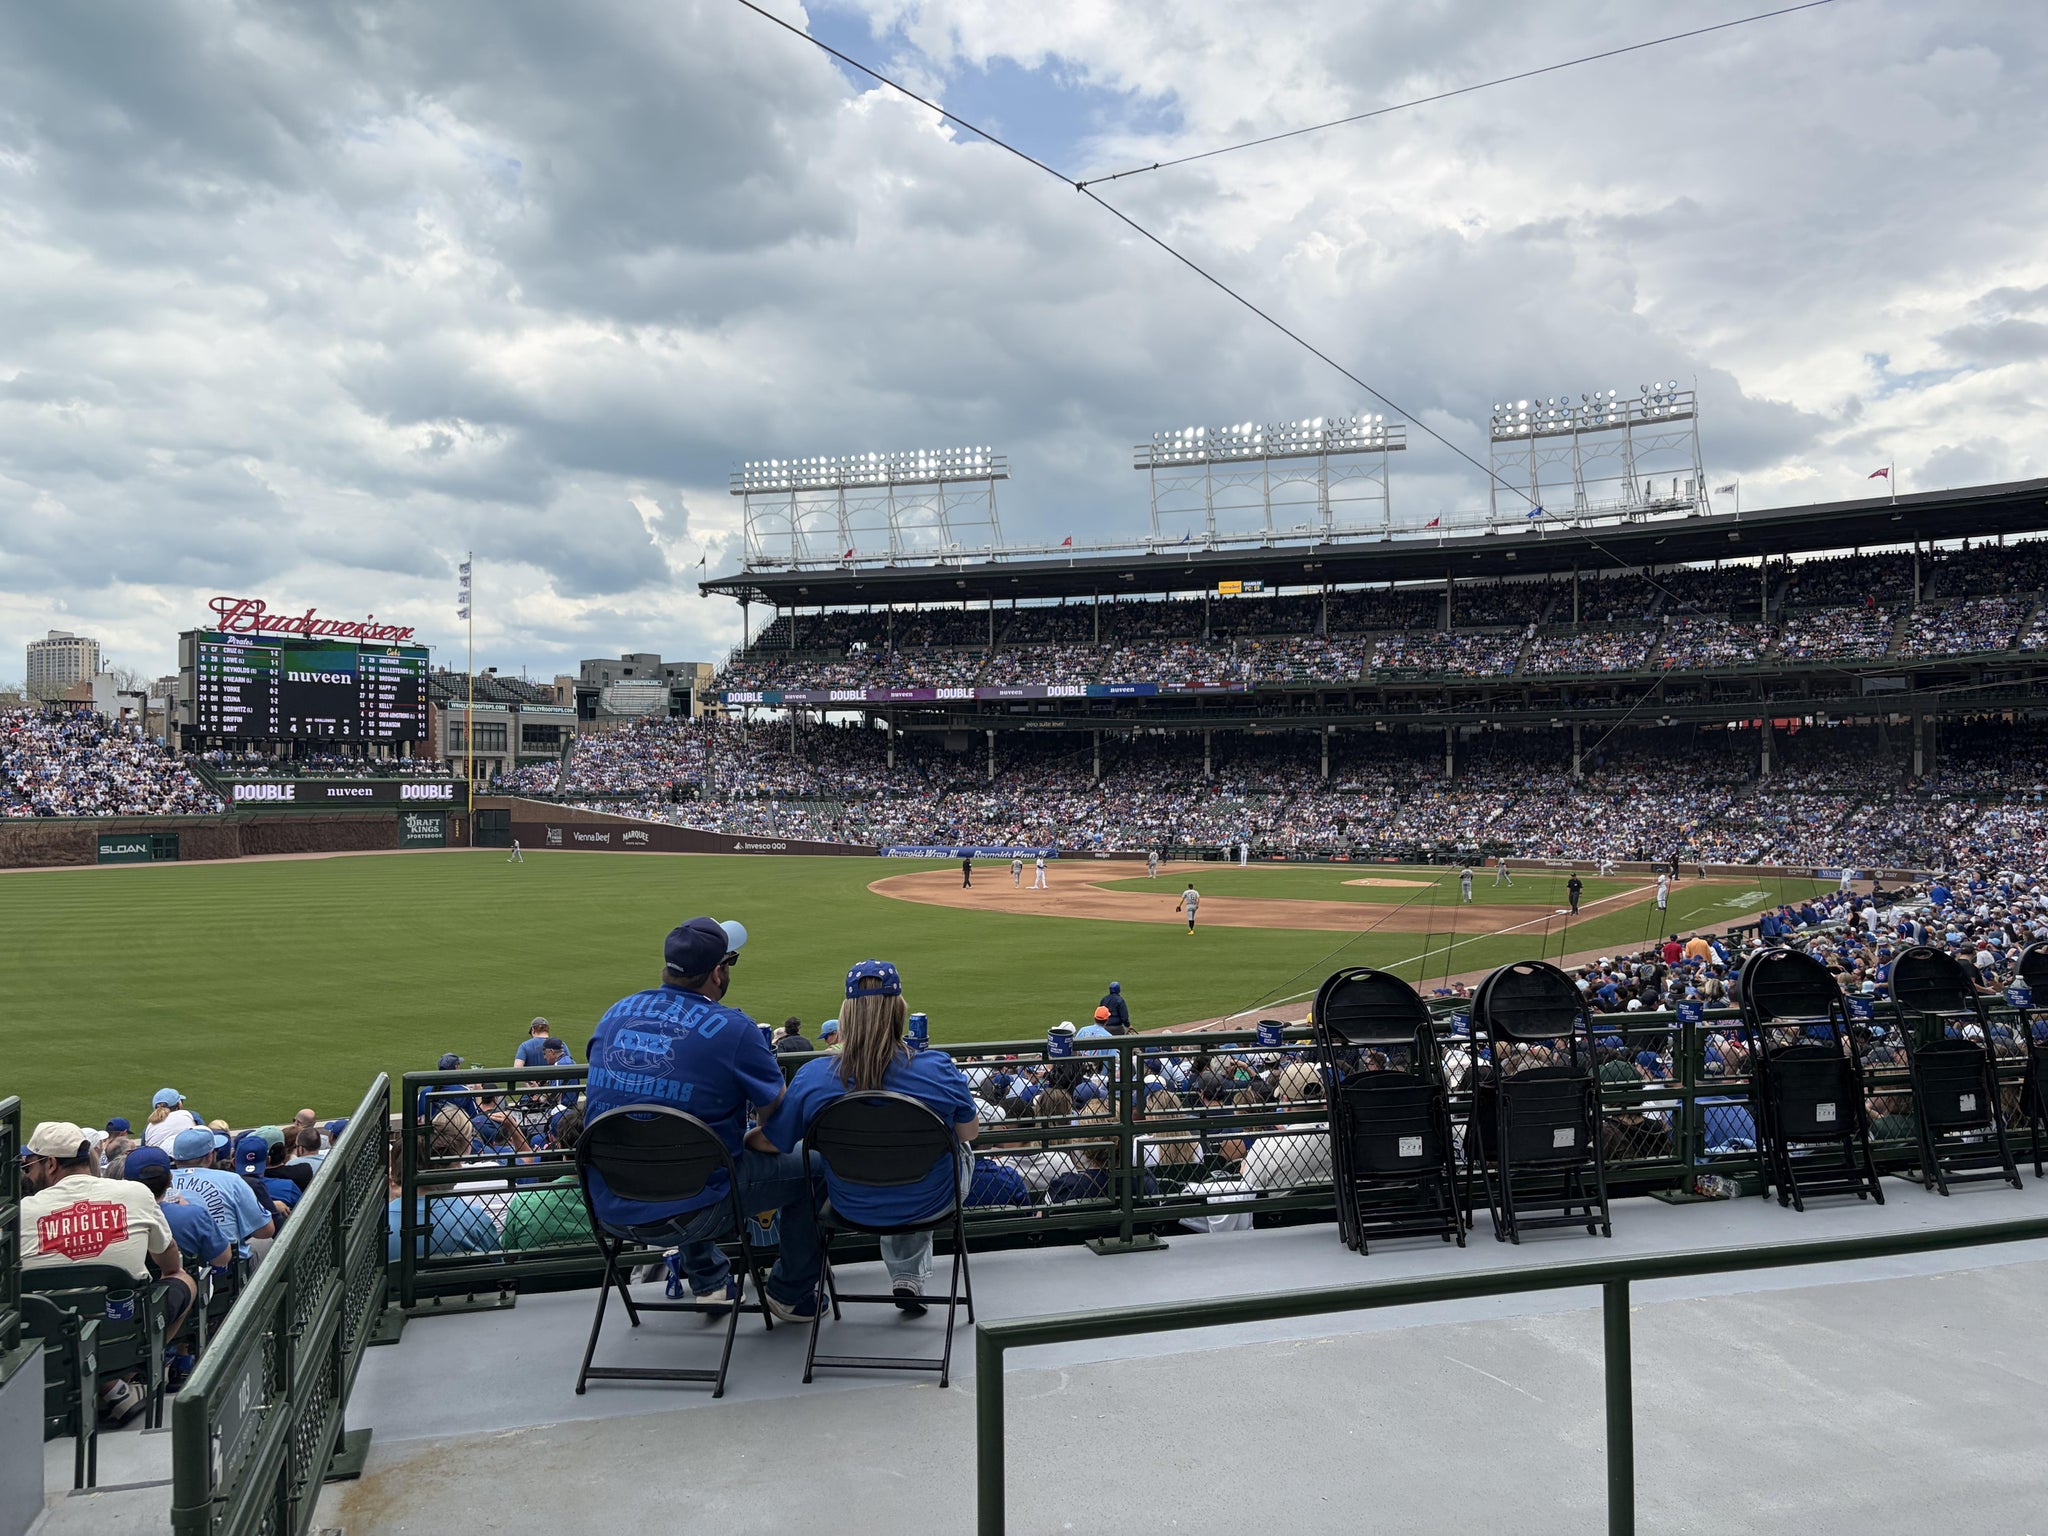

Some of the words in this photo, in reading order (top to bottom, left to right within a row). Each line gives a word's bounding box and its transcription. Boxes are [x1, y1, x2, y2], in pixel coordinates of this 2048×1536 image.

[209, 597, 415, 641] Budweiser
[227, 636, 253, 646] Pirates
[386, 648, 400, 656] Cubs
[288, 671, 352, 684] nuveen
[728, 692, 763, 703] DOUBLE
[830, 690, 867, 700] DOUBLE
[936, 688, 974, 699] DOUBLE
[1048, 686, 1087, 697] DOUBLE
[290, 724, 297, 733] 4
[306, 725, 311, 734] 1
[328, 725, 334, 734] 2
[343, 726, 349, 734] 3
[234, 785, 295, 800] DOUBLE
[327, 788, 373, 796] nuveen
[400, 785, 453, 799] DOUBLE
[406, 819, 440, 828] DRAFT
[574, 832, 594, 842] Vienna
[596, 832, 610, 844] Beef
[623, 831, 649, 842] MARQUEE
[100, 844, 146, 854] SLOAN
[888, 849, 924, 858] Reynolds
[588, 1066, 694, 1102] ORTHSIDERS
[45, 1210, 119, 1240] WRIGLEY
[65, 1232, 103, 1247] FIELD
[68, 1245, 102, 1254] CHICAGO
